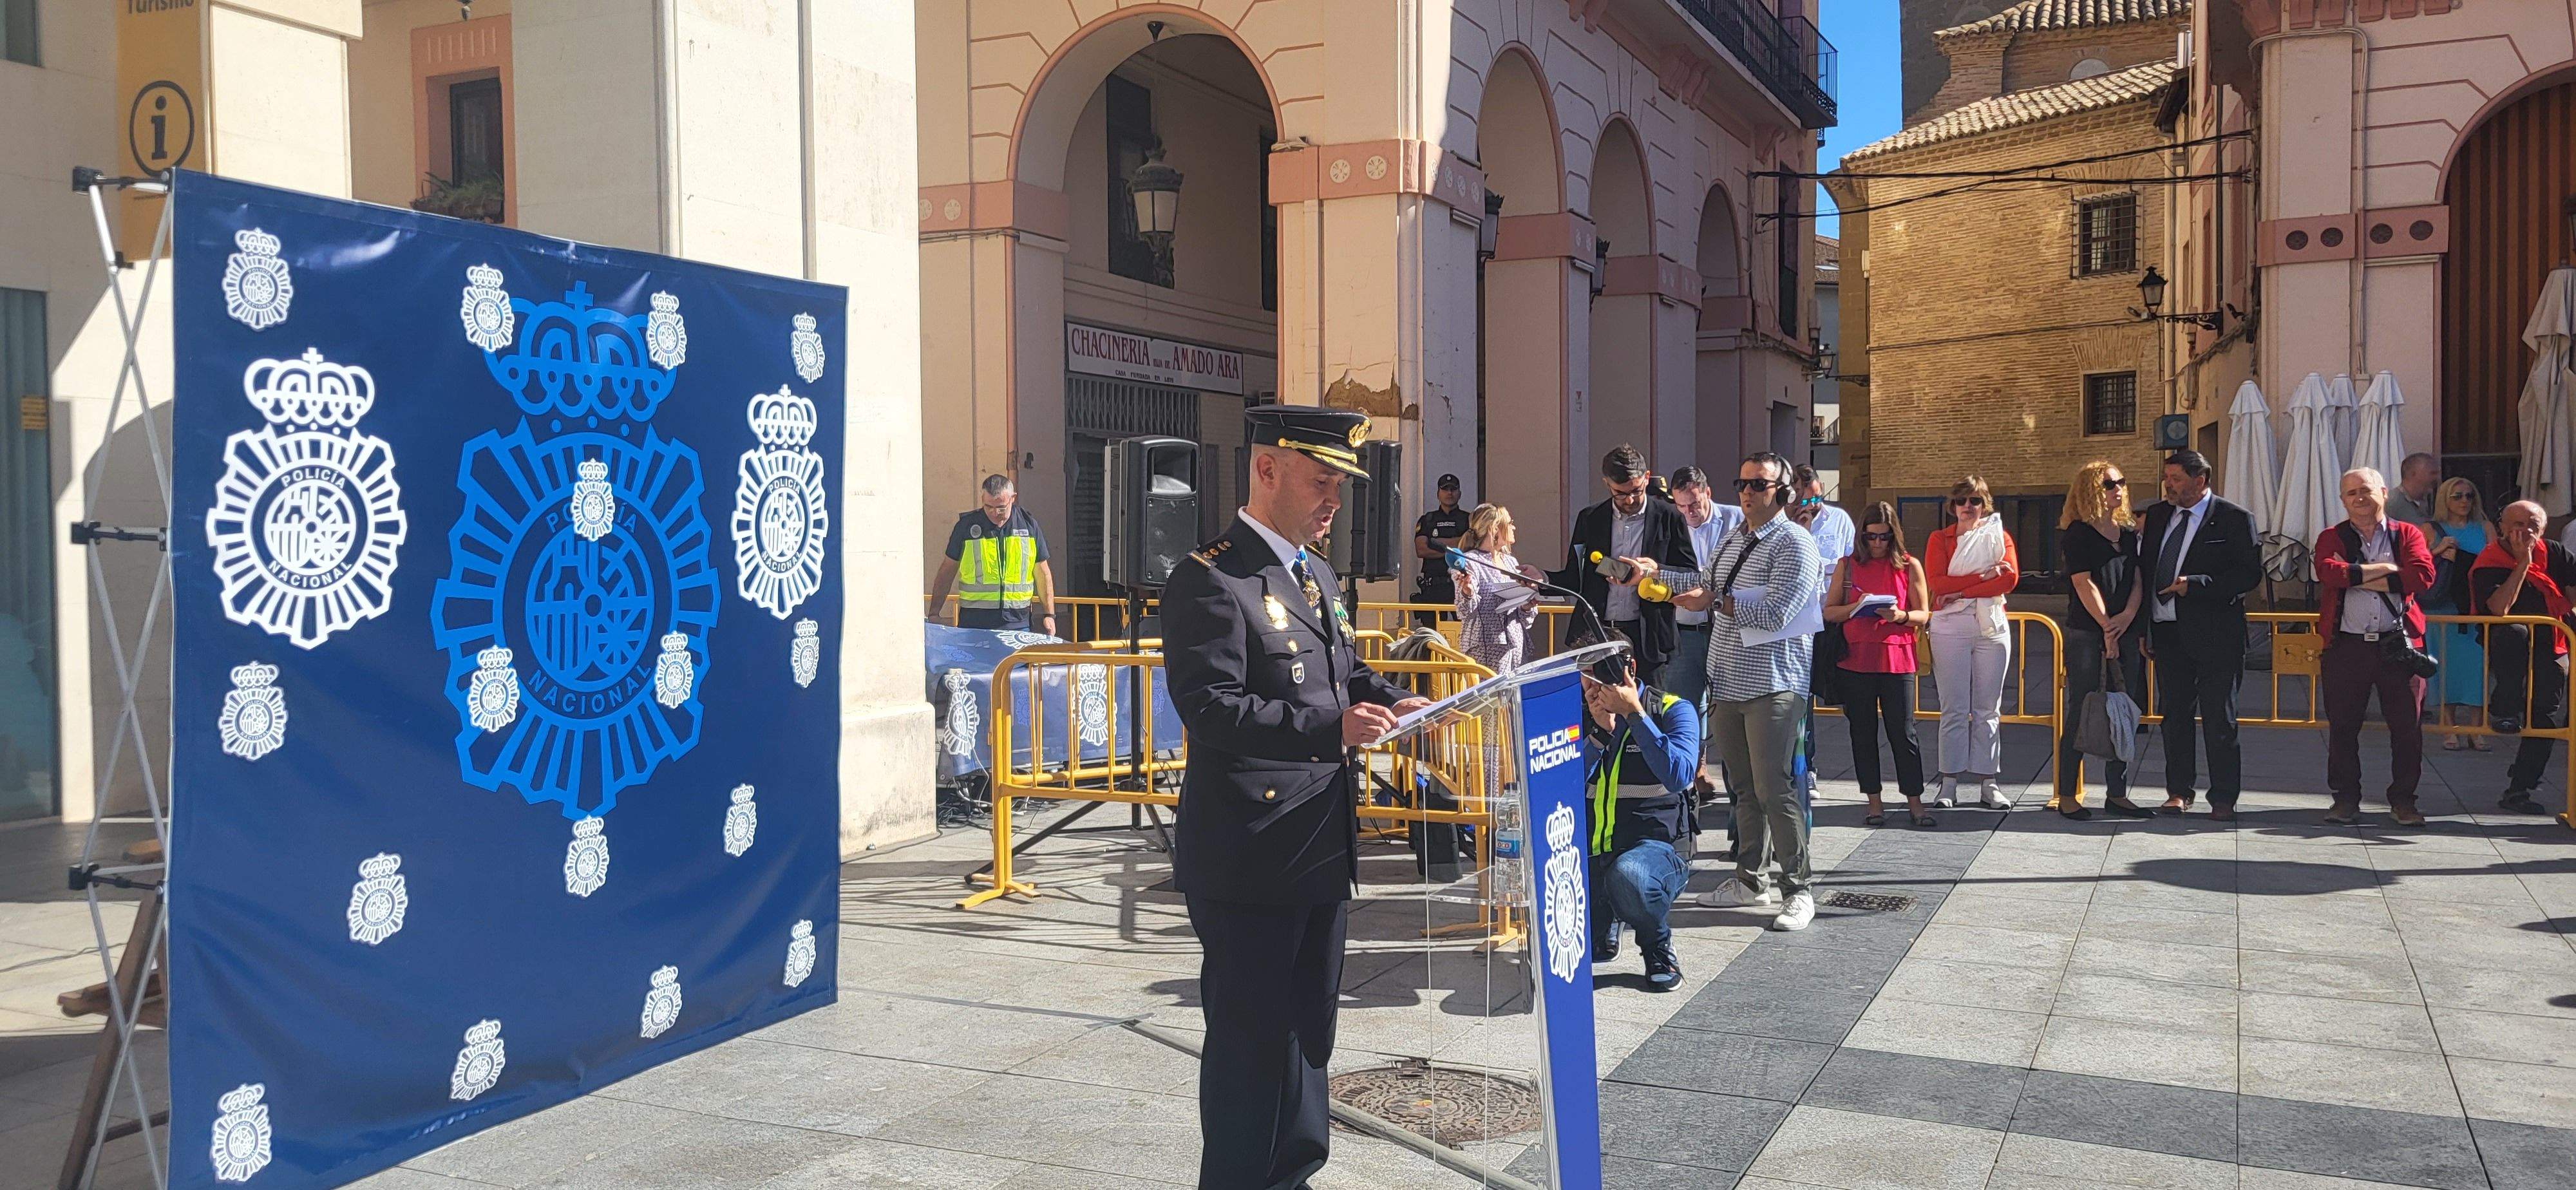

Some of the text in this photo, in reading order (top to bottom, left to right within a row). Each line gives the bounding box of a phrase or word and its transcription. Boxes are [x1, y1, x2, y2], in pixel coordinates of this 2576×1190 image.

[1072, 328, 1150, 366] CHACINERIA
[1173, 346, 1213, 375] AMADO
[1217, 354, 1240, 380] ARA
[281, 468, 346, 489] POLICÍA
[768, 478, 801, 495] POLICÍA
[546, 502, 637, 533] POÍA
[269, 560, 354, 588] NACIONAL
[761, 550, 802, 572] NACIONAL
[529, 664, 654, 714] NACIONAL
[1530, 744, 1581, 775] NACIONAL
